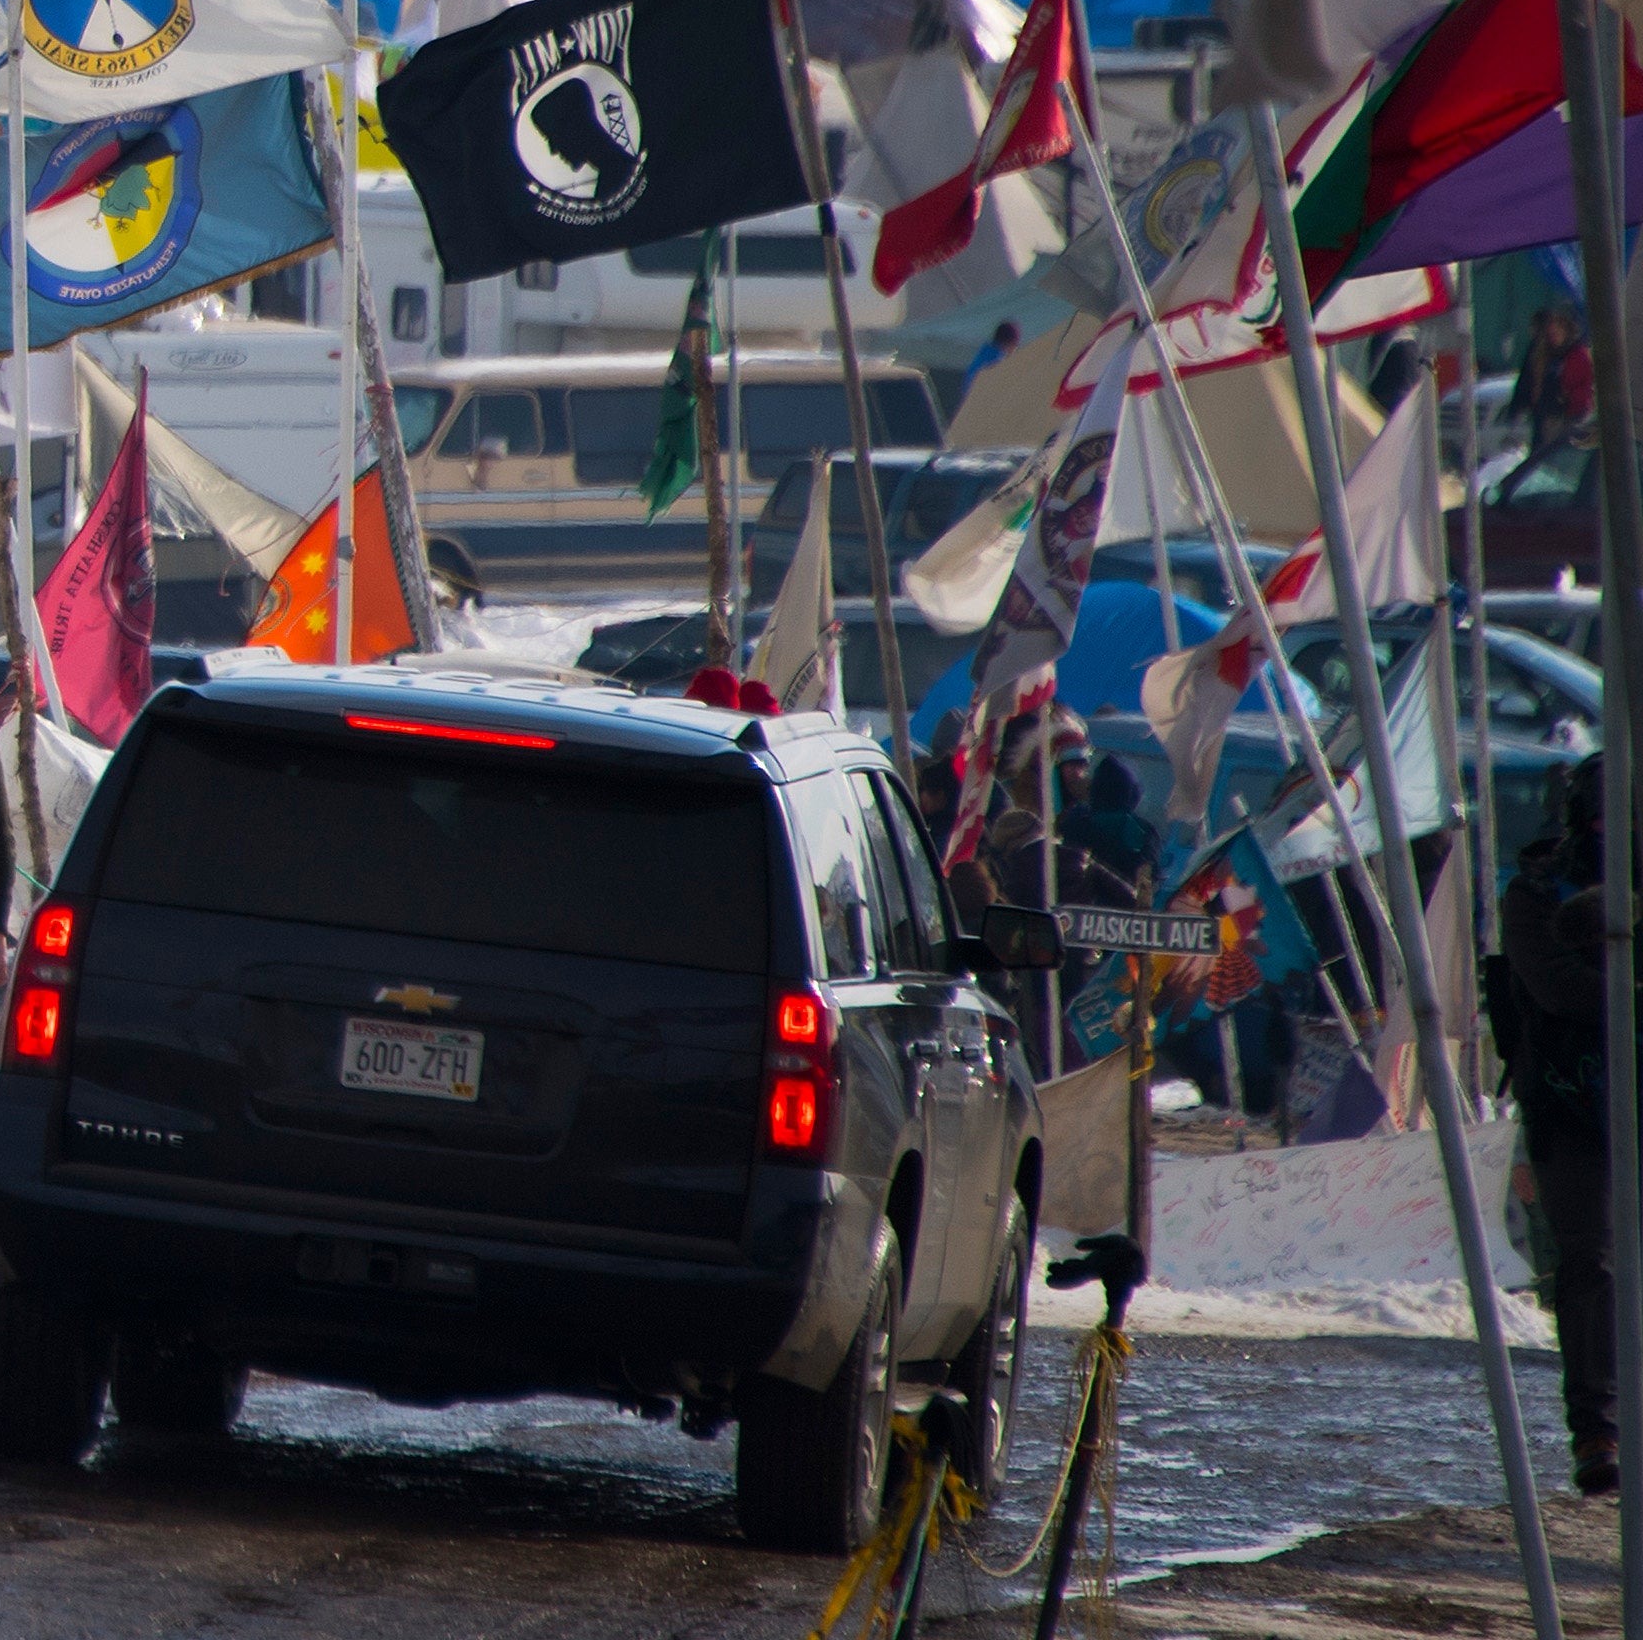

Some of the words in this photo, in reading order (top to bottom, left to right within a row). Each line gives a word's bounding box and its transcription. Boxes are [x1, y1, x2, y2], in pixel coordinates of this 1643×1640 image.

[1079, 914, 1166, 948] HASKELL
[1168, 920, 1213, 950] AVE
[356, 1039, 468, 1084] 600-ZFH
